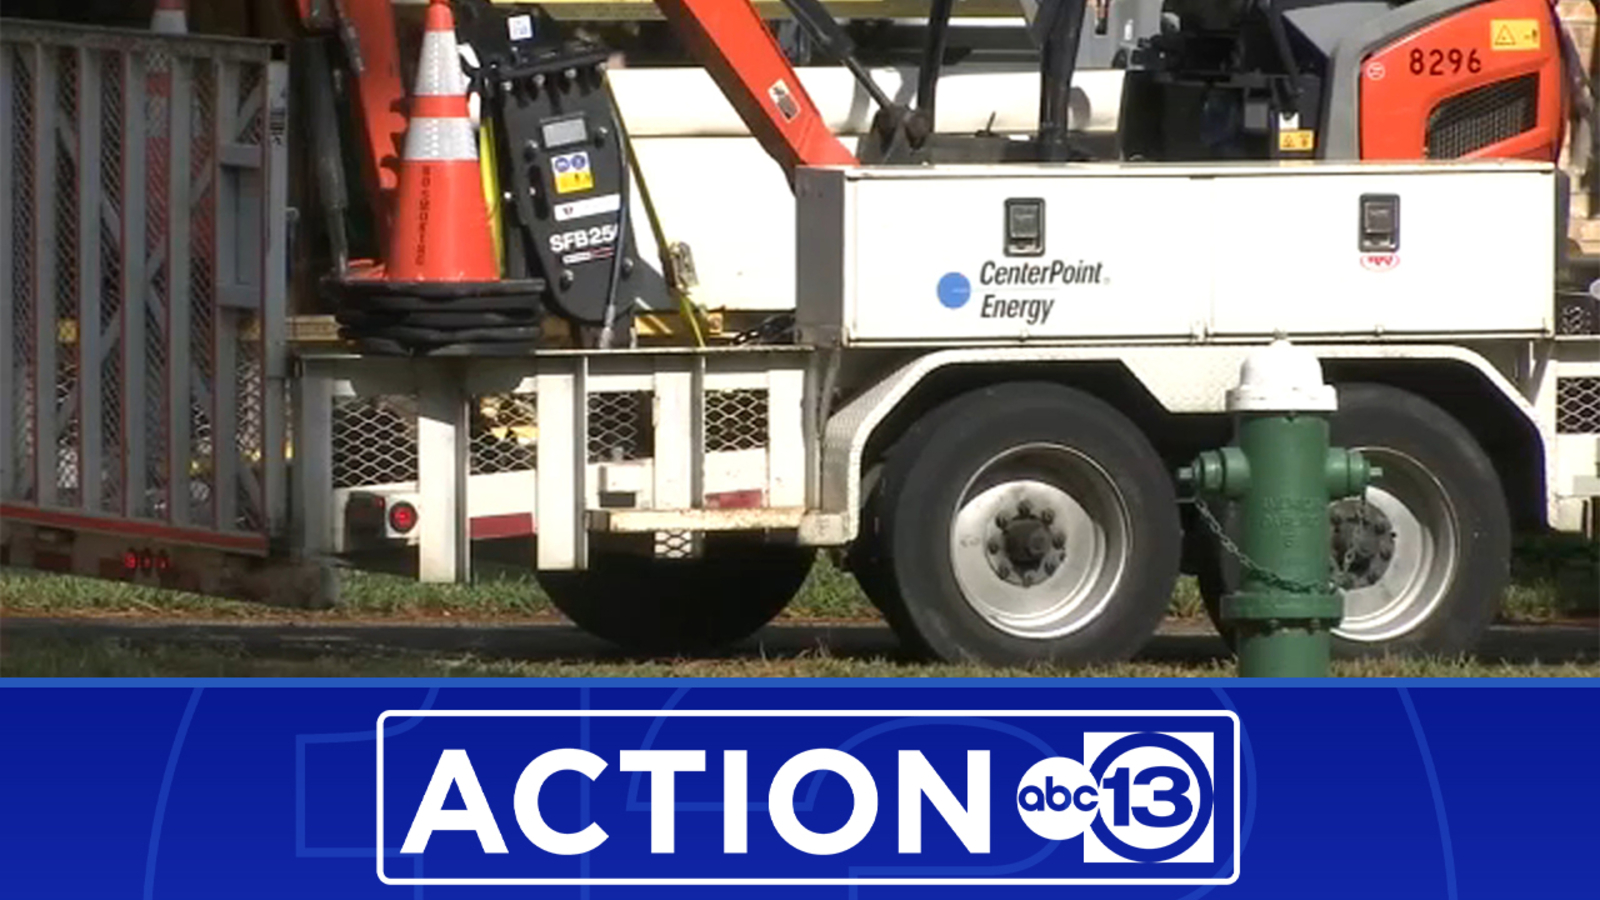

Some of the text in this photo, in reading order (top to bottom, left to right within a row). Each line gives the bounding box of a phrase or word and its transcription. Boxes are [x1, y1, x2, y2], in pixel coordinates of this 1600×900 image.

[1409, 47, 1482, 76] 8296
[979, 259, 1103, 286] CenterPoint
[980, 293, 1055, 326] Energy
